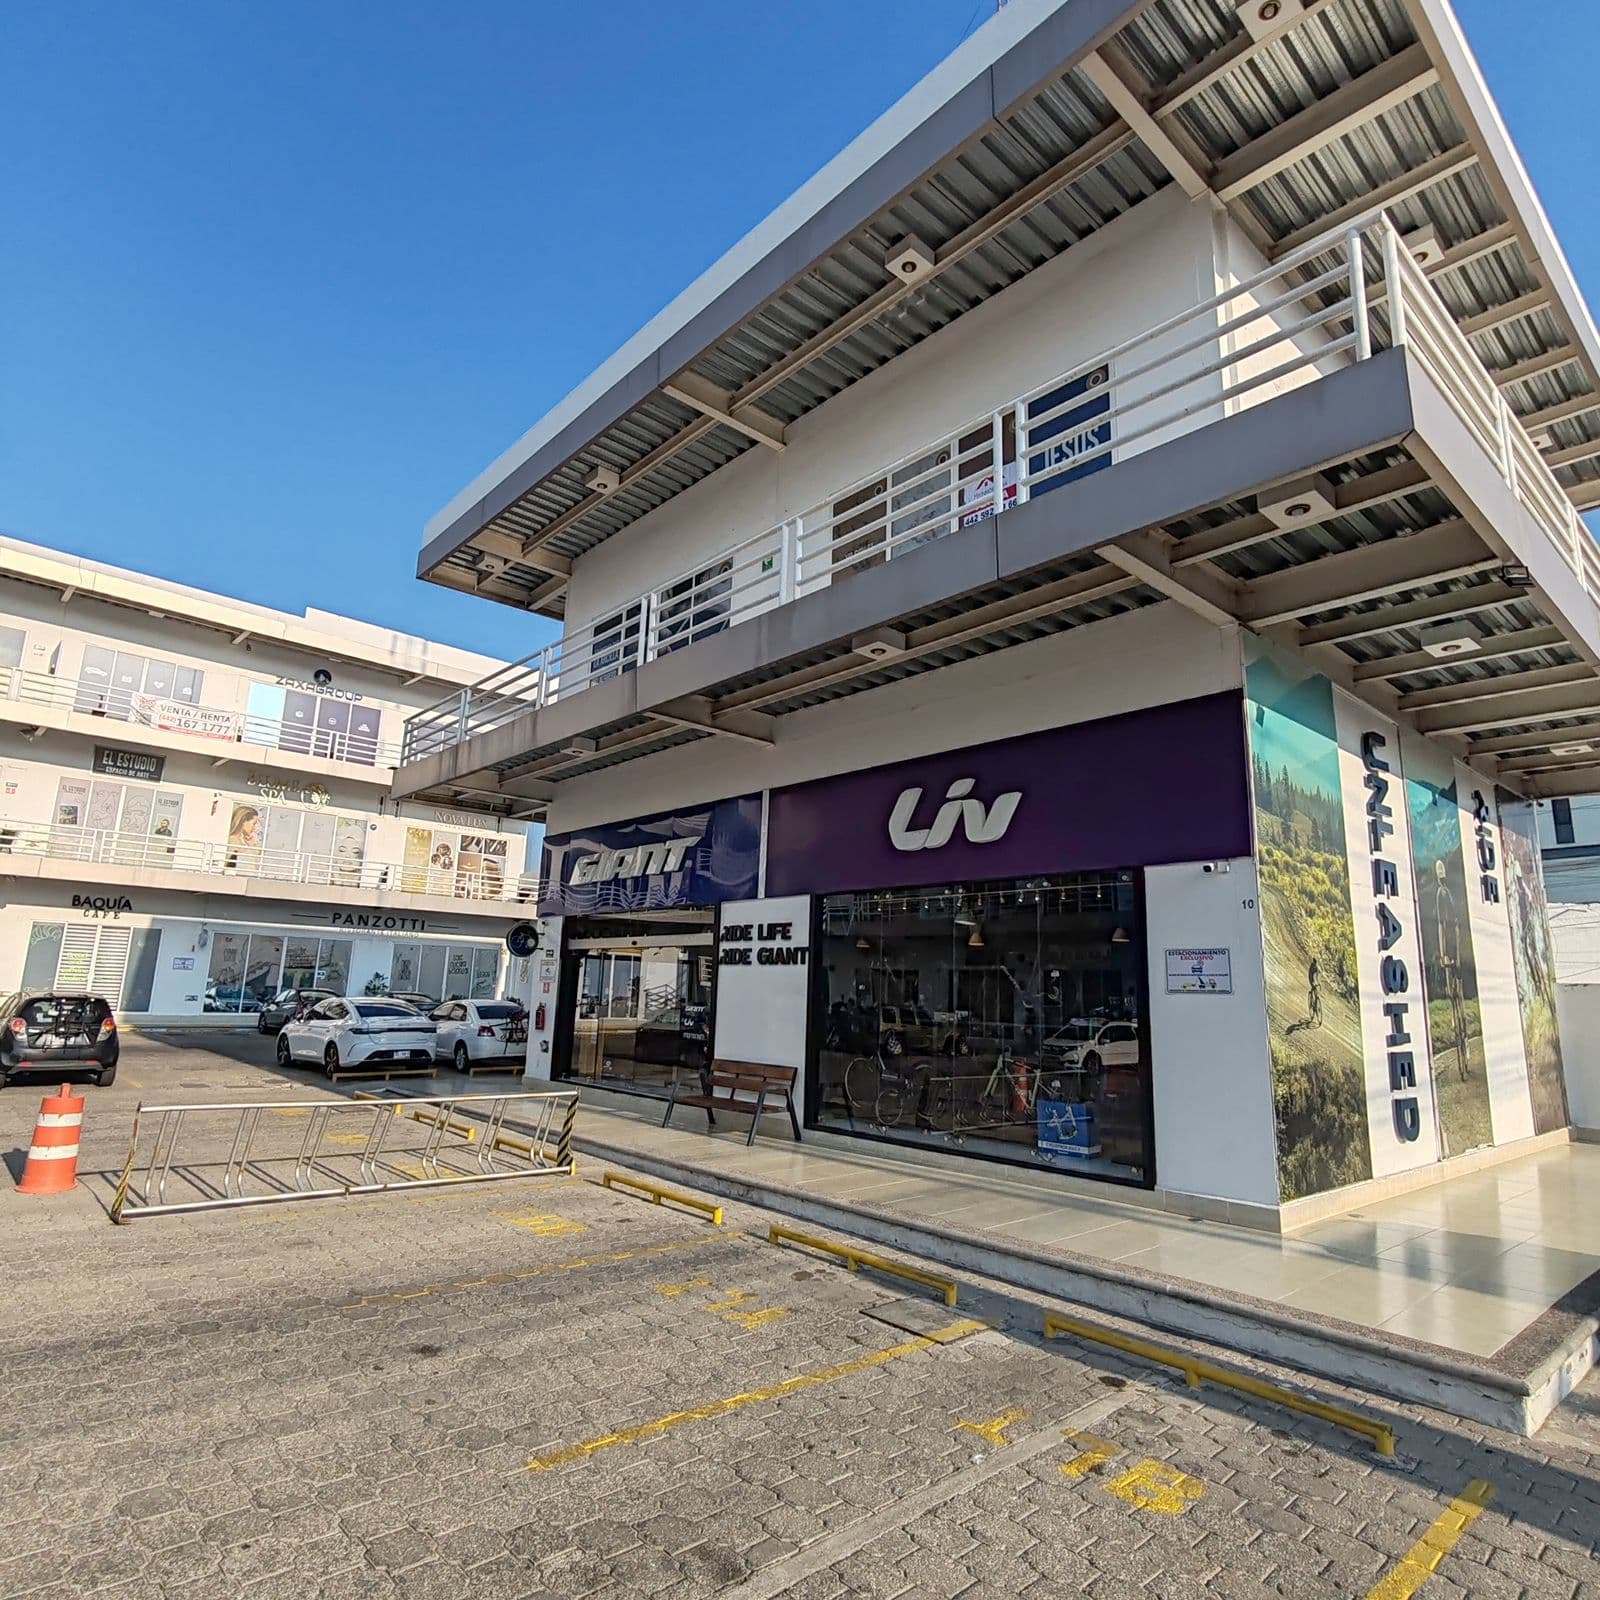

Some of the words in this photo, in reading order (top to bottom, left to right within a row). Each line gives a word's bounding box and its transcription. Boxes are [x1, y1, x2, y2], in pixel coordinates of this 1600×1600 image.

[160, 704, 191, 717] VENTA
[200, 713, 231, 723] RENTA
[176, 718, 197, 729] 167
[202, 722, 230, 734] 1777
[102, 750, 114, 765] EL
[117, 752, 157, 771] ESTUDIO
[260, 787, 287, 806] SPA
[72, 894, 133, 911] BAQUÍA
[1242, 899, 1254, 909] 10
[332, 912, 426, 930] PANZOTTI
[757, 922, 793, 941] LIFE
[1361, 731, 1420, 1143] UNLEASHED
[757, 946, 809, 965] GIANT
